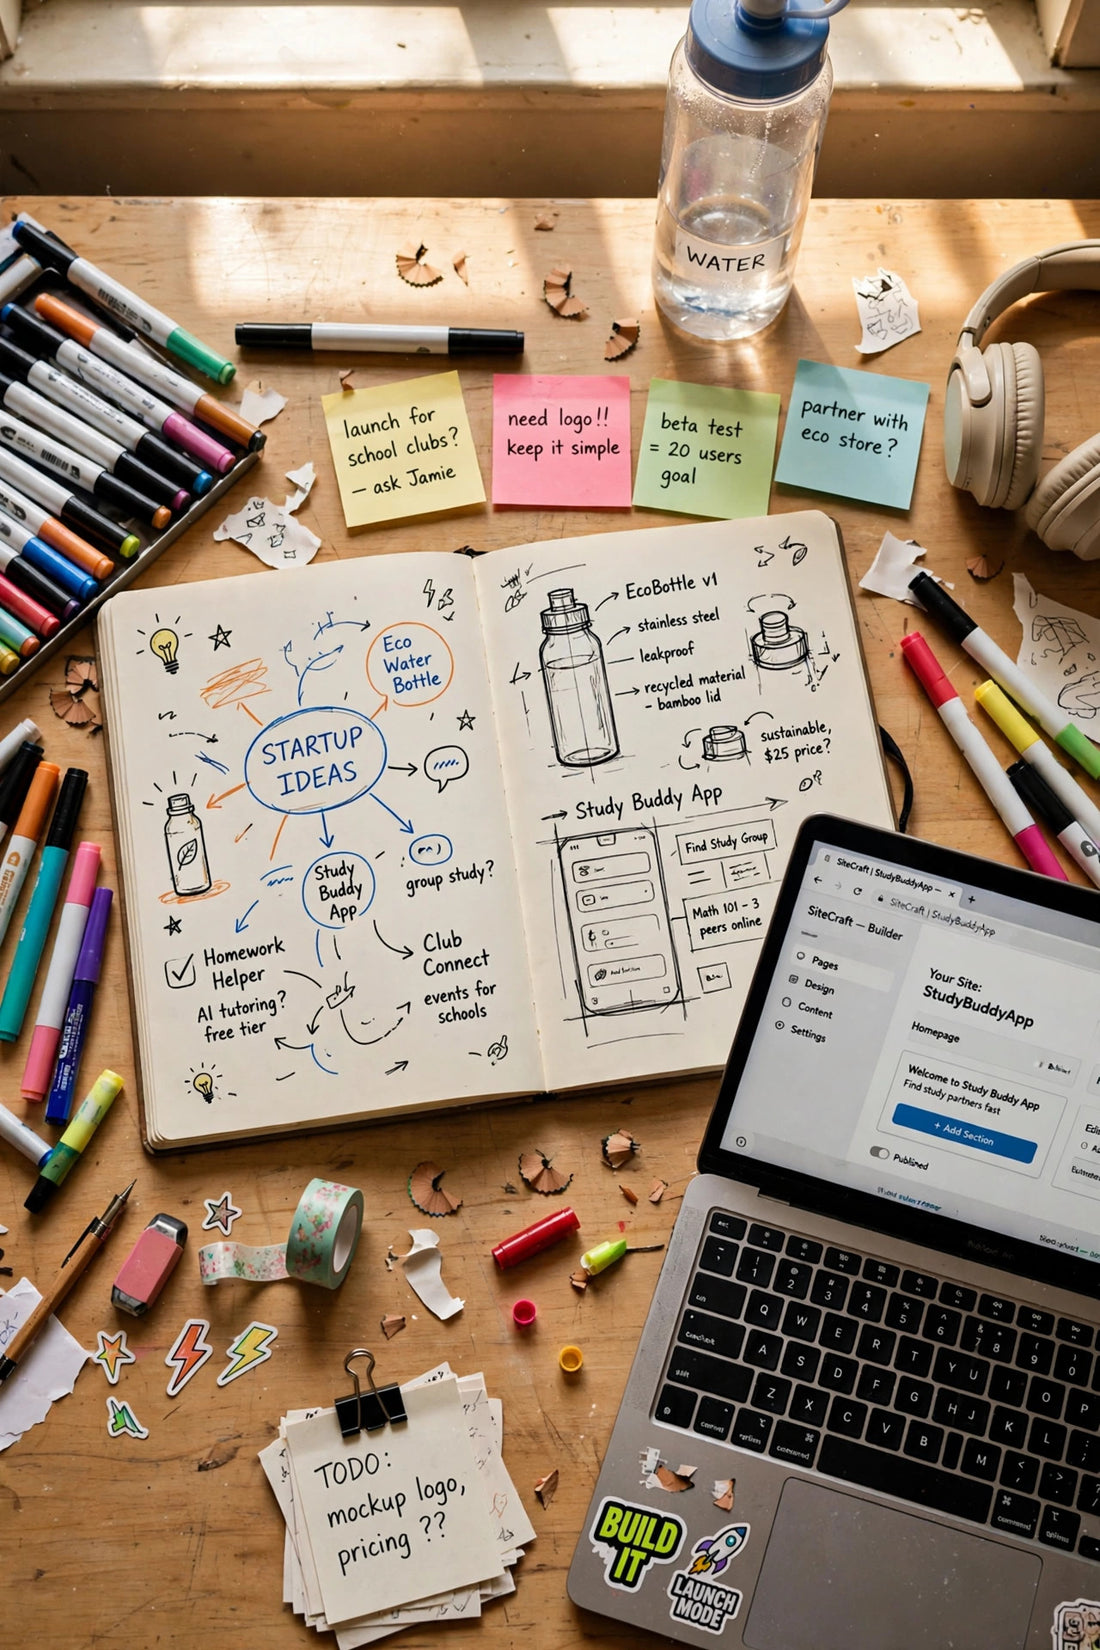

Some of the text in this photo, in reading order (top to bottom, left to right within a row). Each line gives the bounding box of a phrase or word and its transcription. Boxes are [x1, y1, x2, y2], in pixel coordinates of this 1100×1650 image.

[687, 246, 764, 271] WATER
[344, 407, 435, 438] launch for
[509, 407, 608, 434] need logo!!
[662, 412, 743, 437] beta test
[801, 401, 907, 431] partner with
[348, 427, 457, 466] school clubs?
[802, 428, 829, 442] eco
[508, 438, 620, 461] keep it simple
[668, 442, 690, 457] 20
[699, 447, 742, 465] users
[374, 475, 401, 494] ask
[406, 466, 456, 486] Jamie
[661, 467, 696, 488] goal
[626, 572, 717, 599] EcoBottle v1
[638, 607, 719, 632] stainless steel
[383, 635, 411, 652] Eco
[640, 641, 694, 664] leakproof
[384, 655, 431, 673] Water
[393, 671, 441, 693] Bottle
[645, 665, 745, 696] recycled material
[657, 694, 701, 710] bamboo
[706, 688, 721, 703] lid
[761, 720, 831, 742] sustainable,
[262, 726, 362, 765] STARTUP
[765, 738, 830, 764] $25 price?
[277, 761, 356, 796] IDEAS
[576, 784, 722, 820] Study Buddy App
[686, 832, 769, 853] Find Study Group
[314, 860, 354, 881] Study
[406, 860, 494, 897] group study?
[837, 858, 869, 873] SiteCraft
[875, 868, 934, 893] StudyBuddyApp
[319, 881, 362, 901] Buddy
[330, 904, 357, 923] App
[693, 907, 719, 919] Math
[724, 901, 738, 913] 101
[752, 898, 759, 909] 3
[891, 898, 924, 915] SiteCraft
[700, 917, 762, 940] peers online
[808, 905, 853, 926] SiteCraft
[868, 923, 903, 940] Builder
[204, 936, 285, 966] Homework
[424, 930, 462, 952] Club
[424, 949, 489, 976] Connect
[812, 956, 838, 970] Pages
[213, 968, 265, 991] Helper
[805, 979, 834, 995] Design
[931, 968, 982, 992] Your Site:
[424, 980, 496, 1005] events for
[198, 990, 286, 1023] AI tutoring?
[439, 1002, 487, 1024] schools
[799, 1002, 832, 1019] Content
[923, 985, 1033, 1030] StudyBuddyApp
[205, 1022, 266, 1042] free tier
[791, 1025, 825, 1042] Settings
[912, 1021, 959, 1043] Homepage
[904, 1079, 1000, 1115] Find study partners fast
[909, 1064, 1039, 1112] Welcome to Study Buddy App
[943, 1125, 962, 1135] Add
[962, 1130, 995, 1146] Section
[753, 1269, 1075, 1375] 1 2 3 4 5 6 7 8 9 0
[760, 1305, 768, 1315] Q
[797, 1316, 807, 1325] W
[835, 1328, 842, 1337] E
[873, 1339, 880, 1349] R
[912, 1351, 918, 1360] T
[949, 1362, 956, 1372] Y
[970, 1370, 978, 1380] U
[1042, 1392, 1050, 1402] O
[1081, 1404, 1088, 1412] P
[759, 1345, 1049, 1444] A S D F G H J K L
[767, 1388, 986, 1465] Z X C V B M
[314, 1452, 390, 1488] TODO:
[328, 1477, 465, 1528] mockup logo,
[599, 1506, 678, 1553] BUILD
[338, 1511, 445, 1576] pricing ??
[613, 1547, 647, 1582] IT
[674, 1576, 738, 1612] LAUNCH
[677, 1598, 723, 1628] MODE
